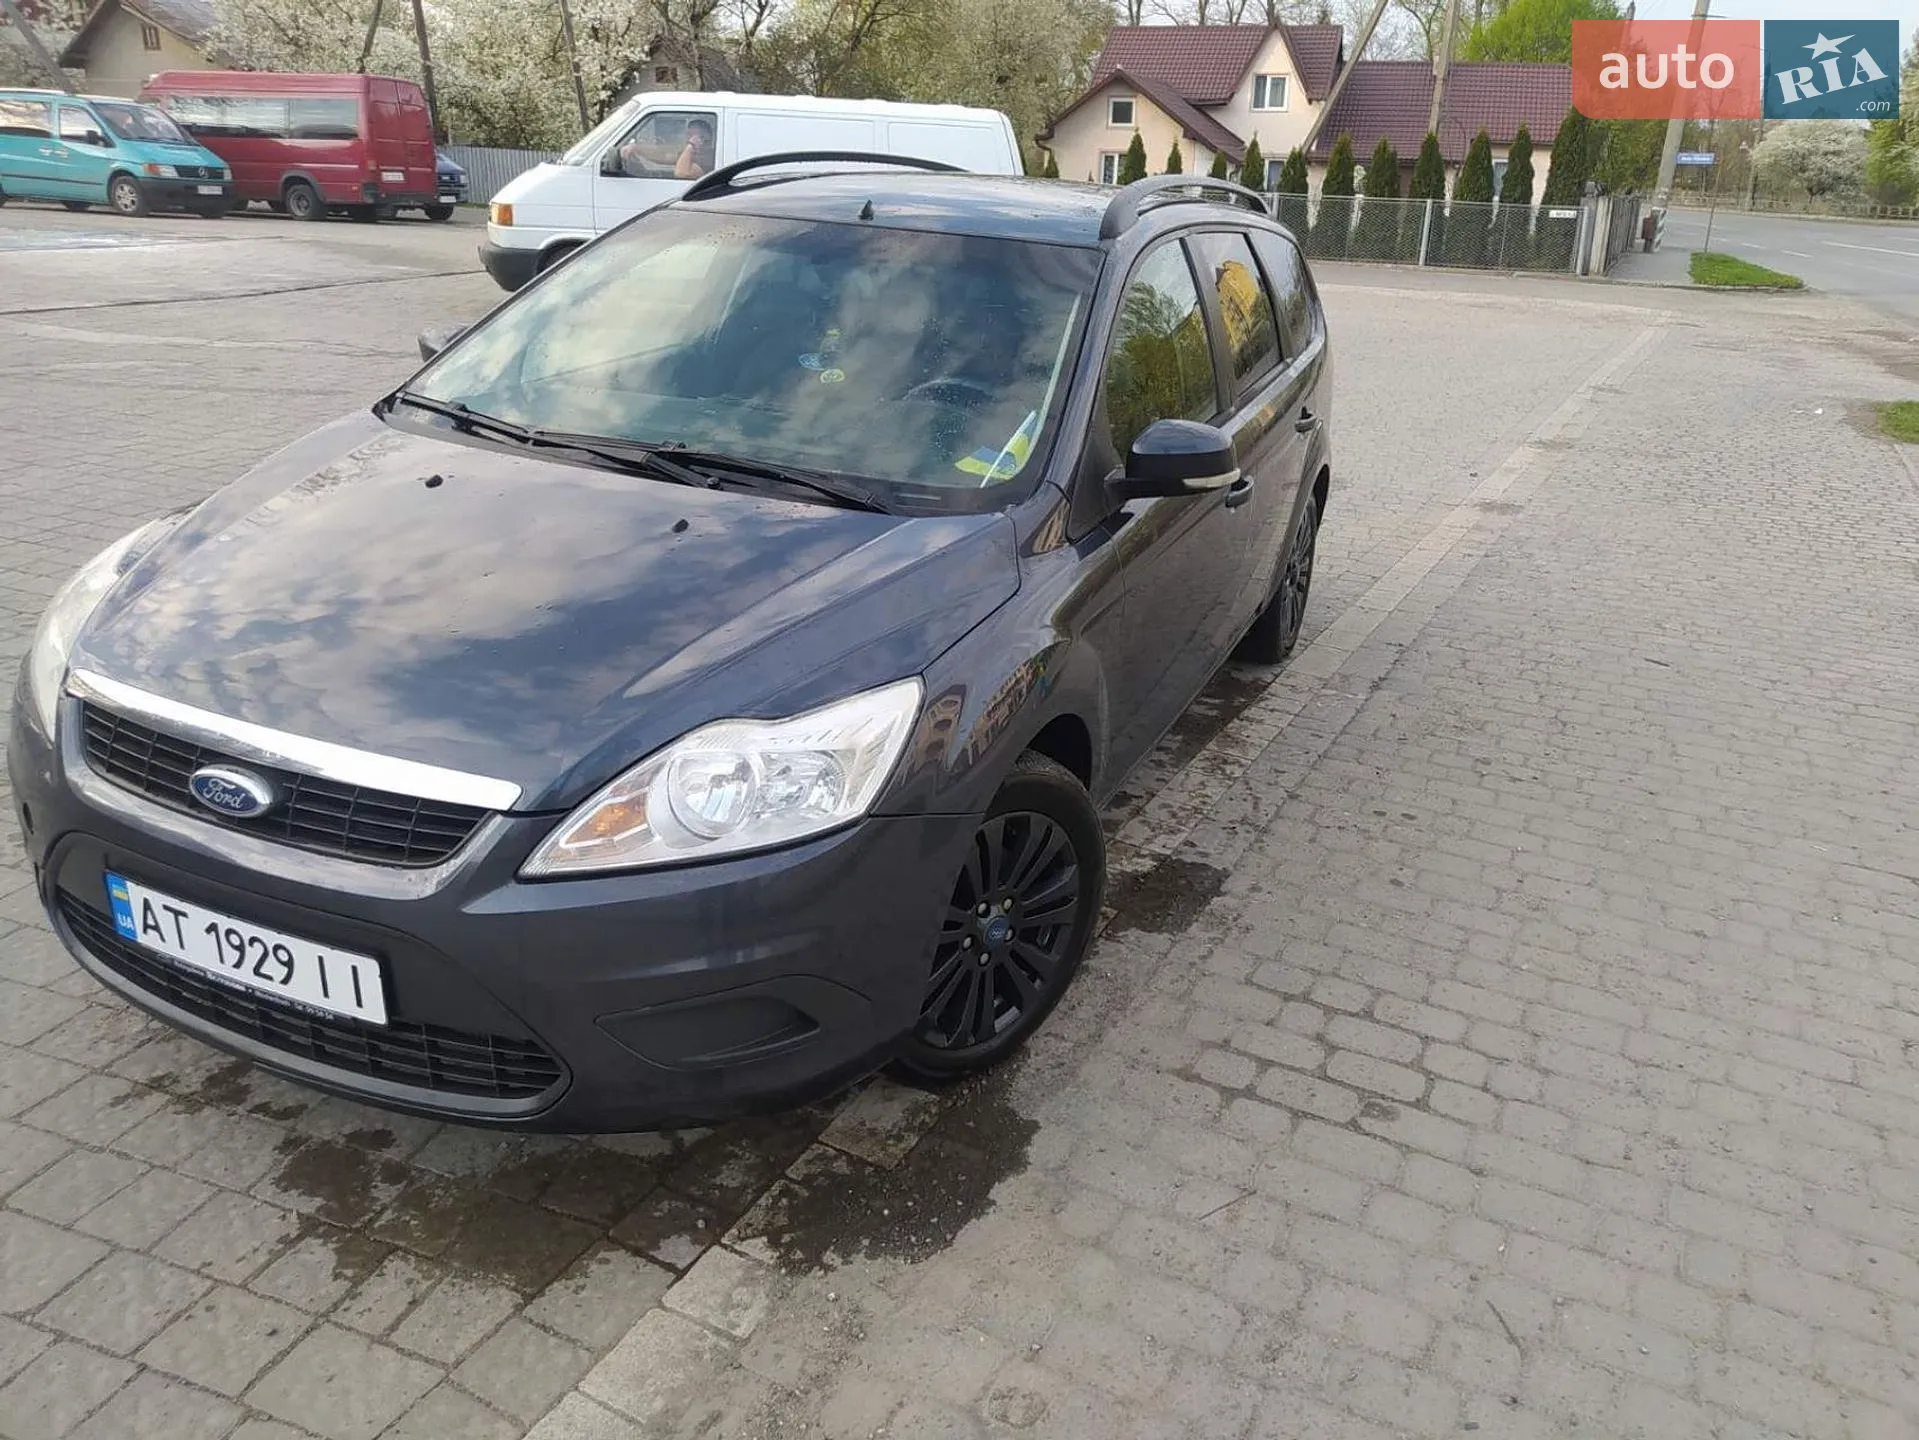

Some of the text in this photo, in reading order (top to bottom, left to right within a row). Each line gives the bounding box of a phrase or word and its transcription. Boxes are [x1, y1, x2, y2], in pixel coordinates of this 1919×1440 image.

[203, 778, 246, 809] Ford
[117, 913, 134, 931] UA
[142, 898, 188, 950] AT
[204, 922, 294, 985] 1929
